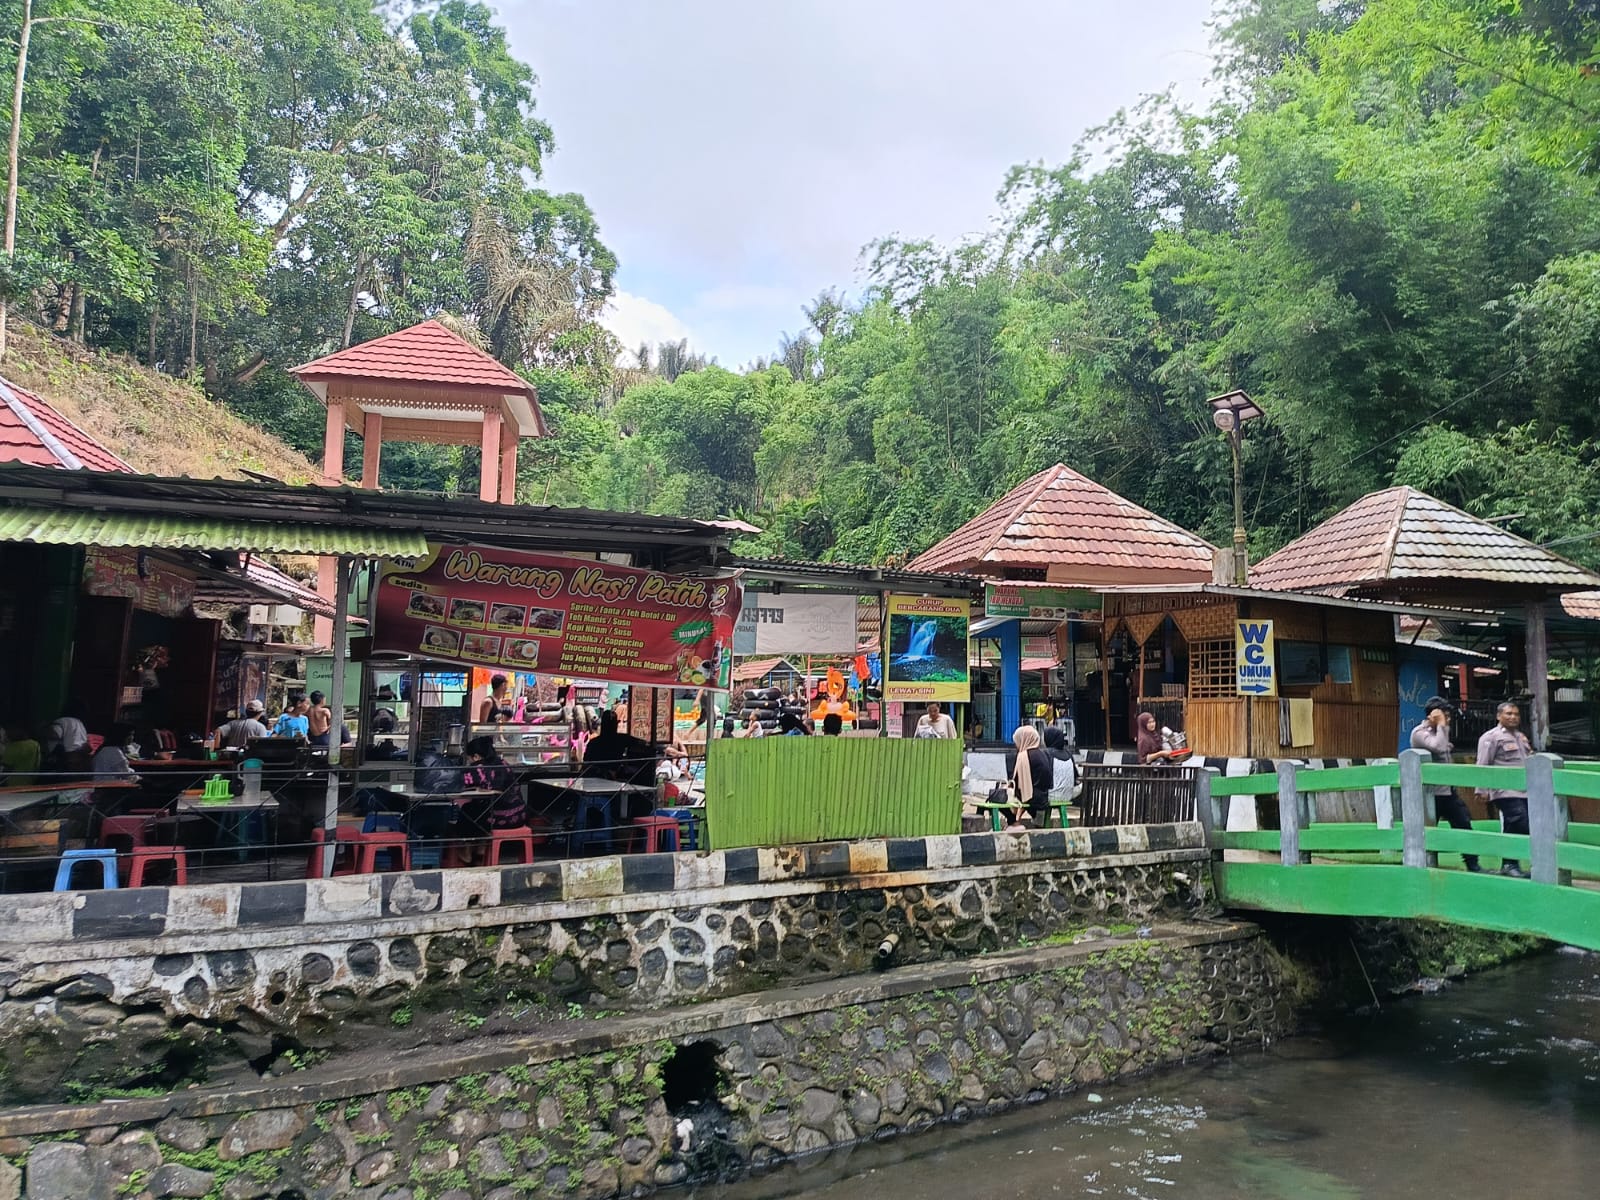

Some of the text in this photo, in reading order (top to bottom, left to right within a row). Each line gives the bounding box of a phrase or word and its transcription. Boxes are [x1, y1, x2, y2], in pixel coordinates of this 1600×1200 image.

[444, 550, 729, 609] Warung Nasi Patih 2
[570, 602, 594, 613] Sprite
[600, 606, 620, 615] Fanta
[626, 609, 639, 617] Teh
[640, 610, 660, 620] Botol
[569, 612, 583, 622] Teh
[583, 614, 606, 624] Manis
[612, 618, 632, 627] Susu
[566, 622, 585, 632] Kopi
[585, 624, 607, 634] Hitam
[613, 628, 632, 636] Susu
[565, 632, 598, 644] Torabika
[604, 637, 645, 648] Cappucino
[612, 647, 626, 657] Pop
[627, 649, 639, 657] Ice
[559, 662, 572, 671] Jus
[561, 653, 574, 661] Jus
[598, 656, 610, 665] Jus
[630, 659, 642, 668] Jus
[643, 661, 673, 671] Mangga
[1239, 665, 1271, 678] UMUM
[888, 687, 917, 695] LEWAT
